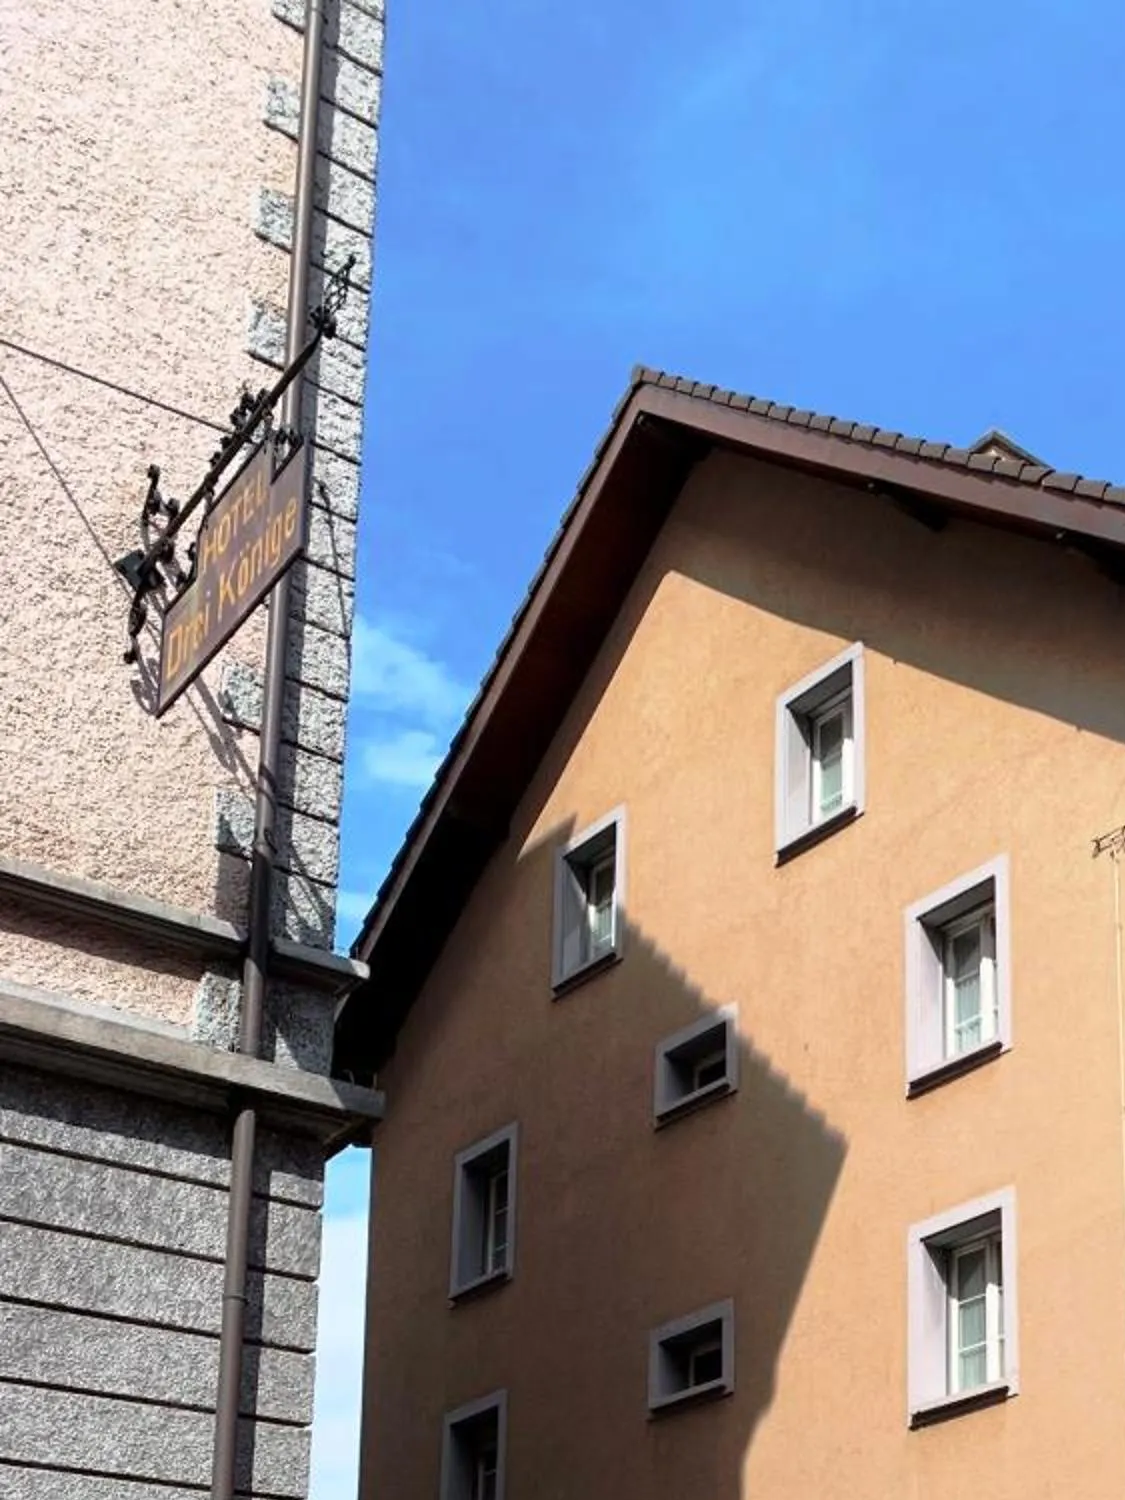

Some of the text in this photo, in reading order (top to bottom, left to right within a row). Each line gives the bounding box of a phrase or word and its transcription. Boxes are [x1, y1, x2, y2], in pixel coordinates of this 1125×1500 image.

[166, 497, 297, 682] Drei Könige
[203, 471, 268, 575] HOTEL
